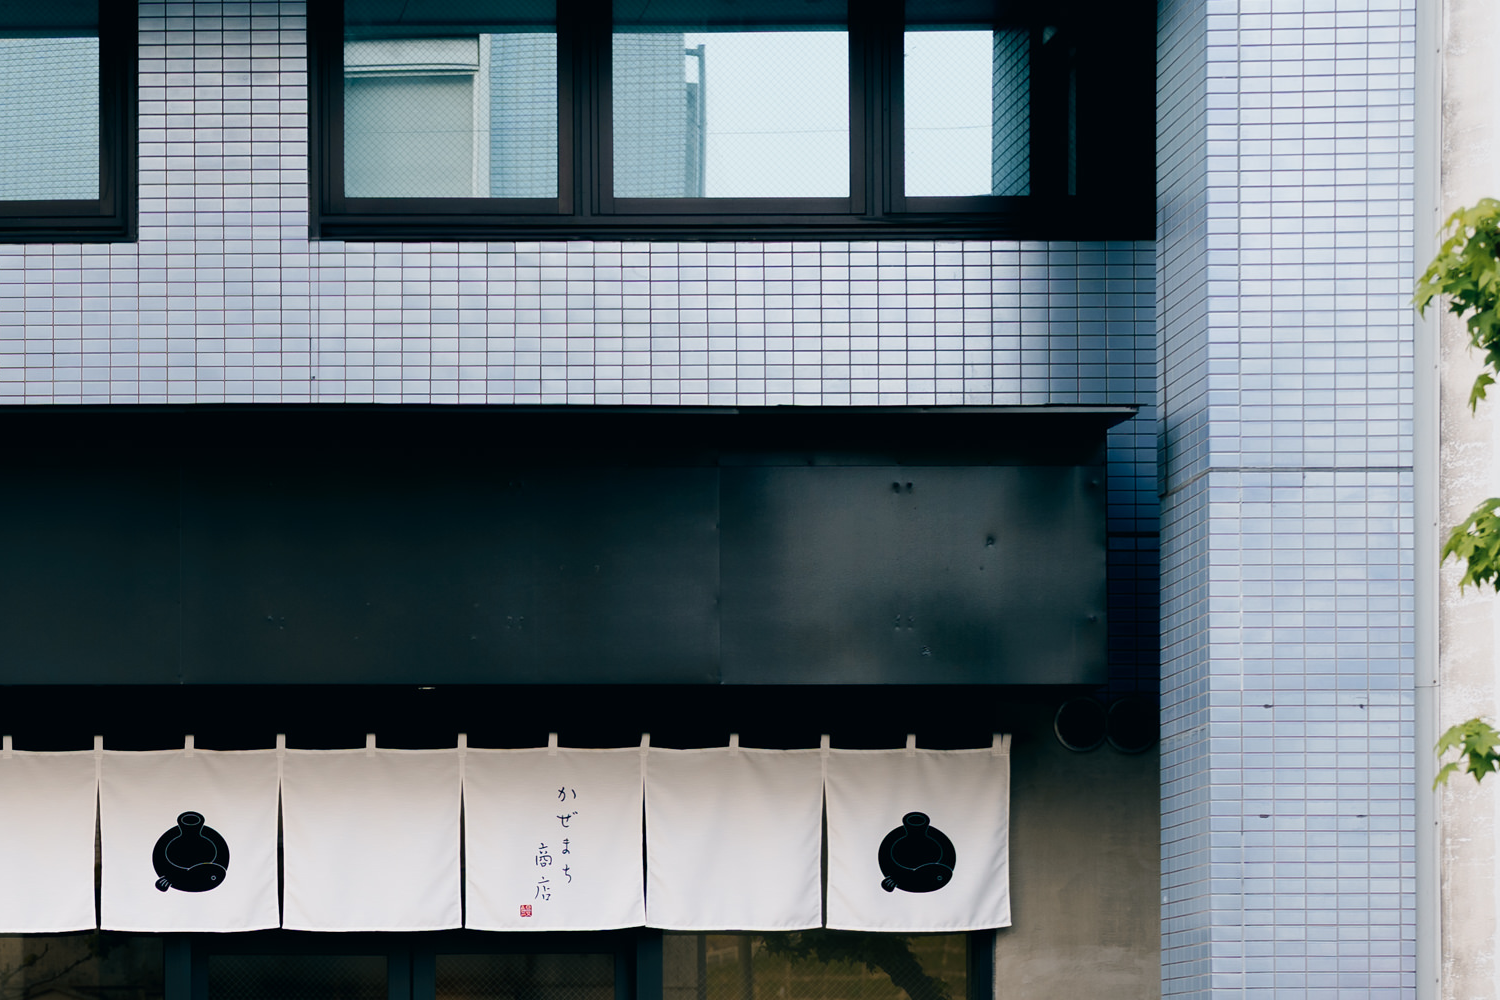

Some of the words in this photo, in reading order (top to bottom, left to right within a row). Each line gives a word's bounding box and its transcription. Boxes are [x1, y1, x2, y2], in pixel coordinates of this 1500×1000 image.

[533, 843, 553, 902] 商店
[556, 786, 578, 884] かぜまち
